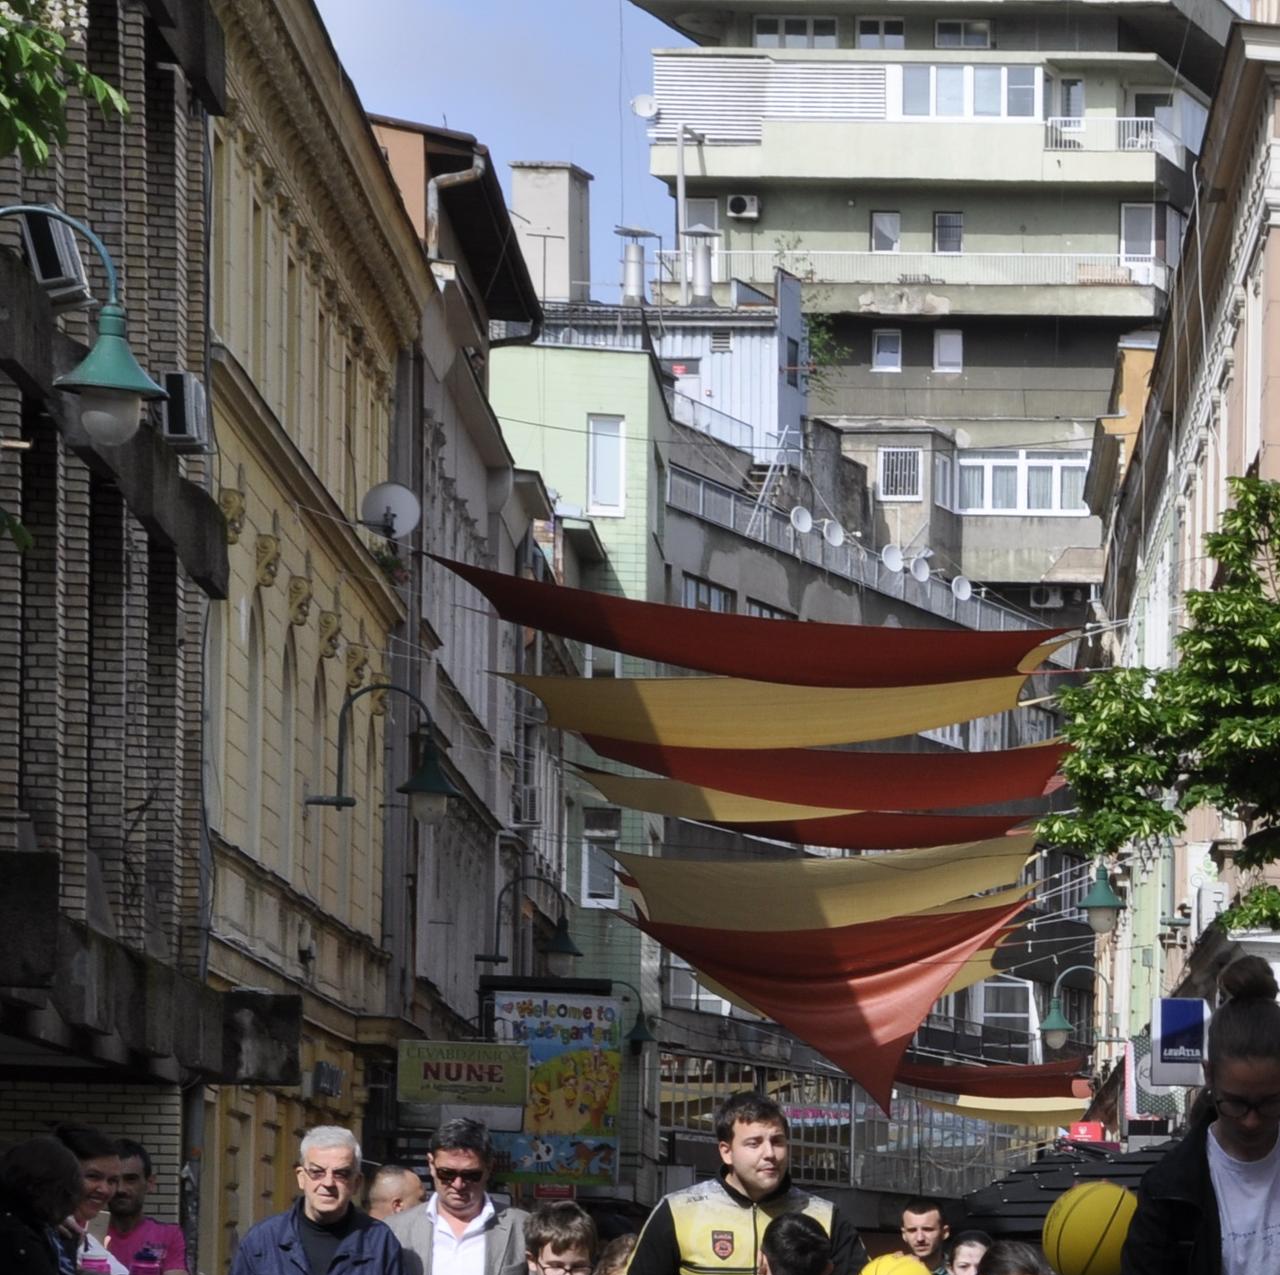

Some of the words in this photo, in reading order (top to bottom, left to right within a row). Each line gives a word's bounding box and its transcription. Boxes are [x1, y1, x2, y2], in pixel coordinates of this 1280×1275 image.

[516, 999, 592, 1019] Welcome
[597, 1006, 616, 1021] to
[423, 1062, 504, 1083] NUNE
